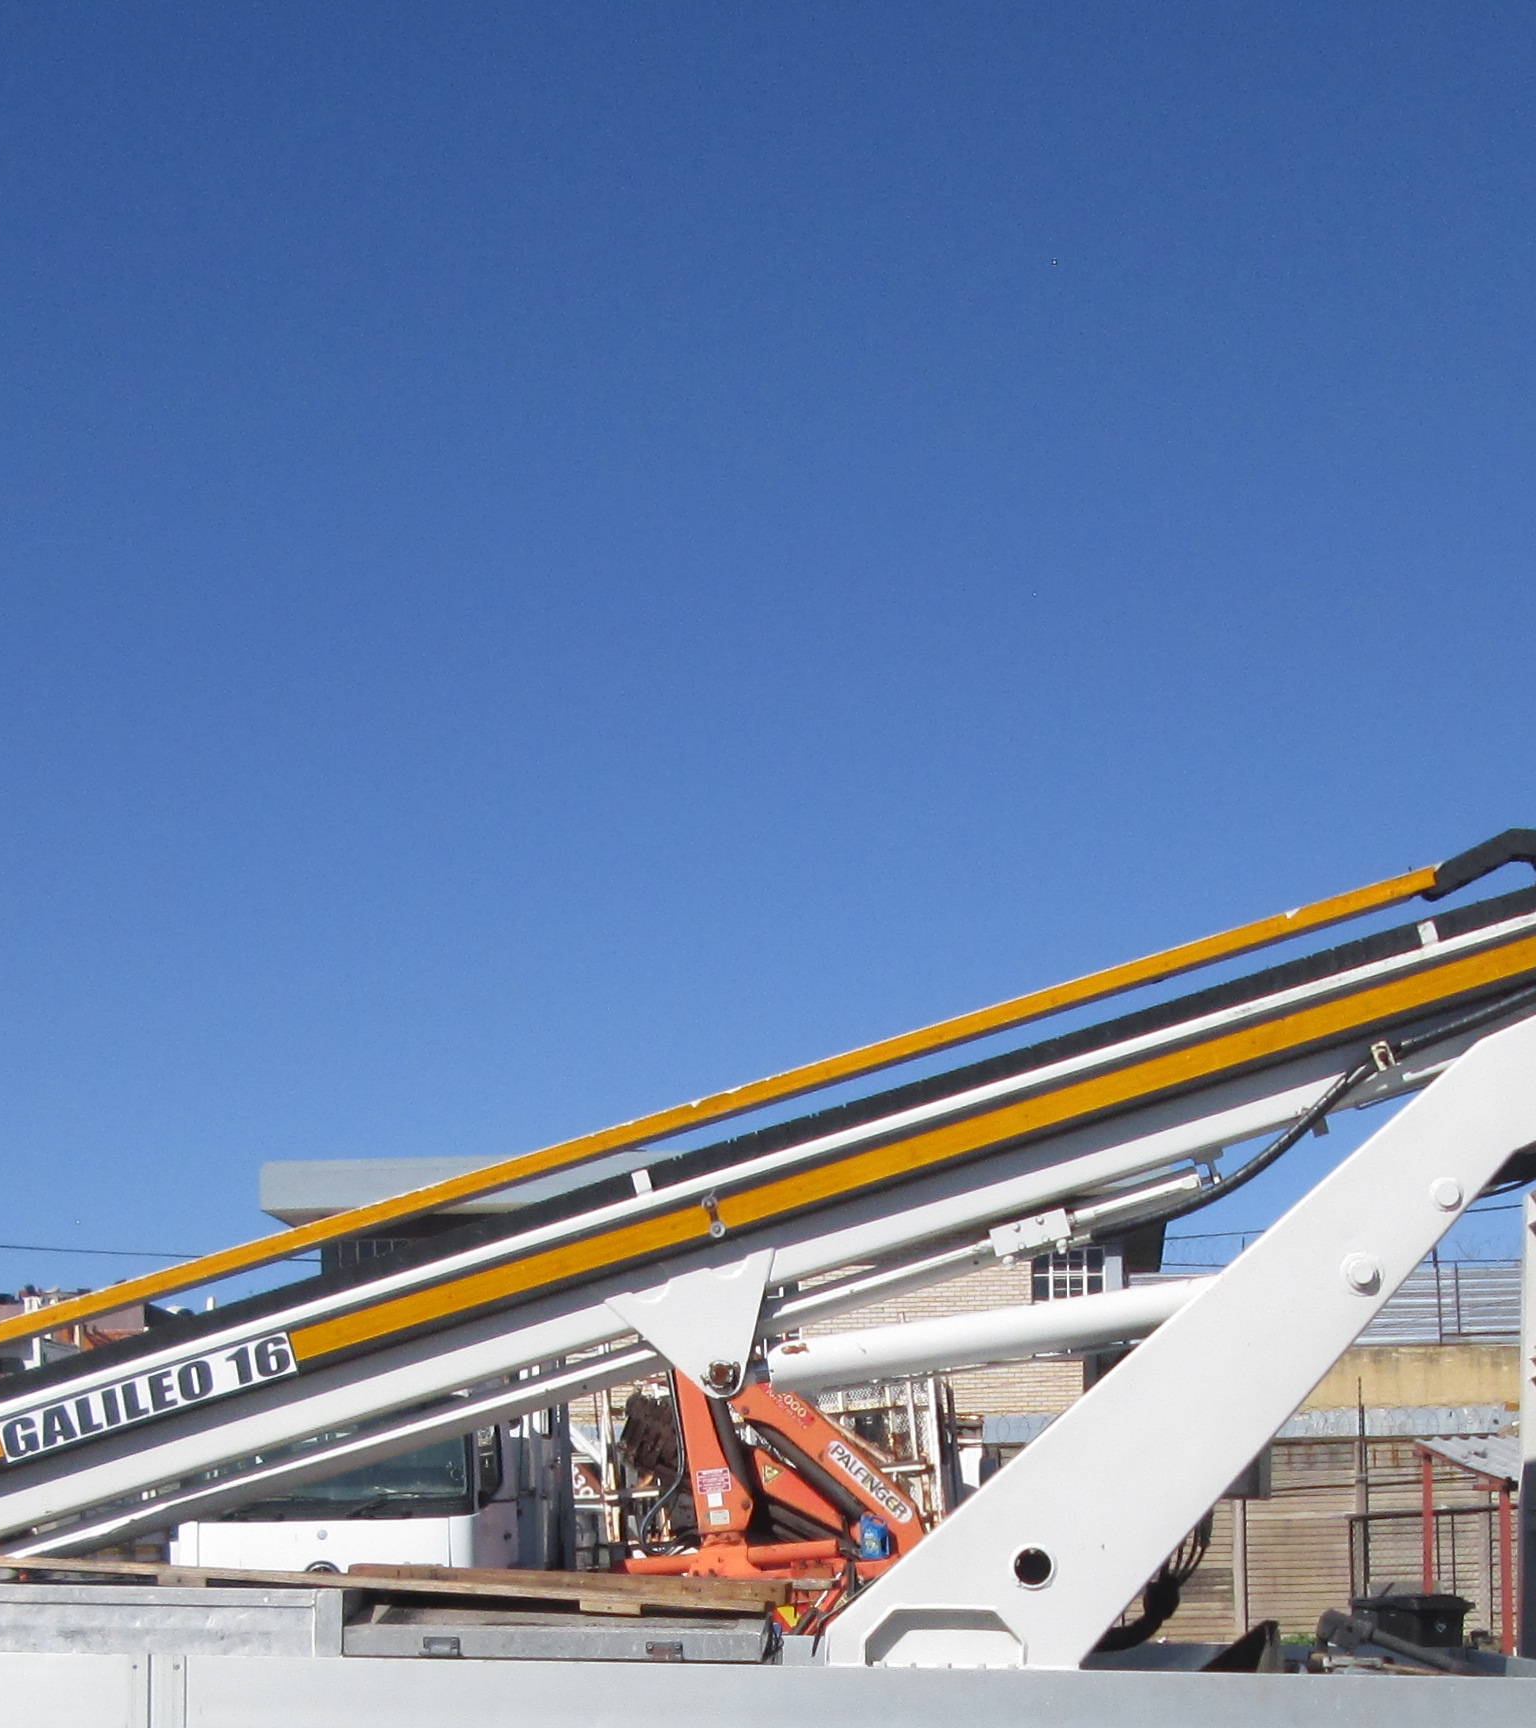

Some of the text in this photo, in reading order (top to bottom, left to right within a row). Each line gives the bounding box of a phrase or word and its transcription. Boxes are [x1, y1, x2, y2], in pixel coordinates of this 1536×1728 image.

[3, 1336, 290, 1458] GALILEO 16
[830, 1443, 907, 1520] PALFINGER
